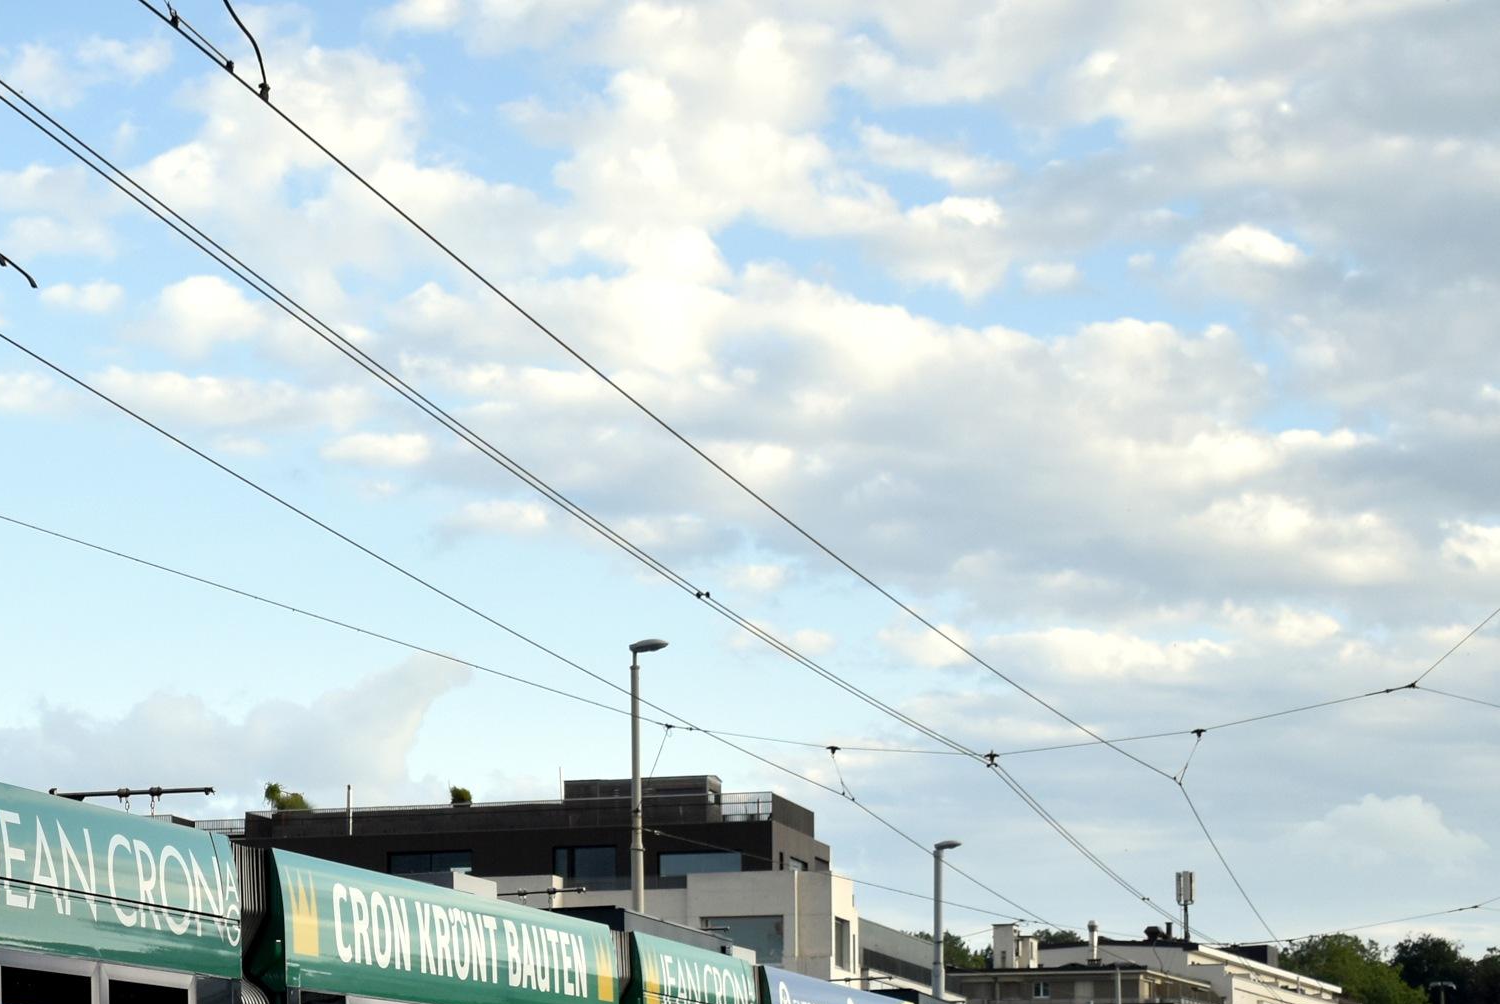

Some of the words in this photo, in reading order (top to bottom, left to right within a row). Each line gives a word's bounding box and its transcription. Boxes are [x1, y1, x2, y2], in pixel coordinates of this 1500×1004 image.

[107, 833, 224, 943] CRON
[332, 882, 411, 971] CRON
[415, 901, 499, 984] KRÖNT
[503, 919, 588, 998] BAUTEN
